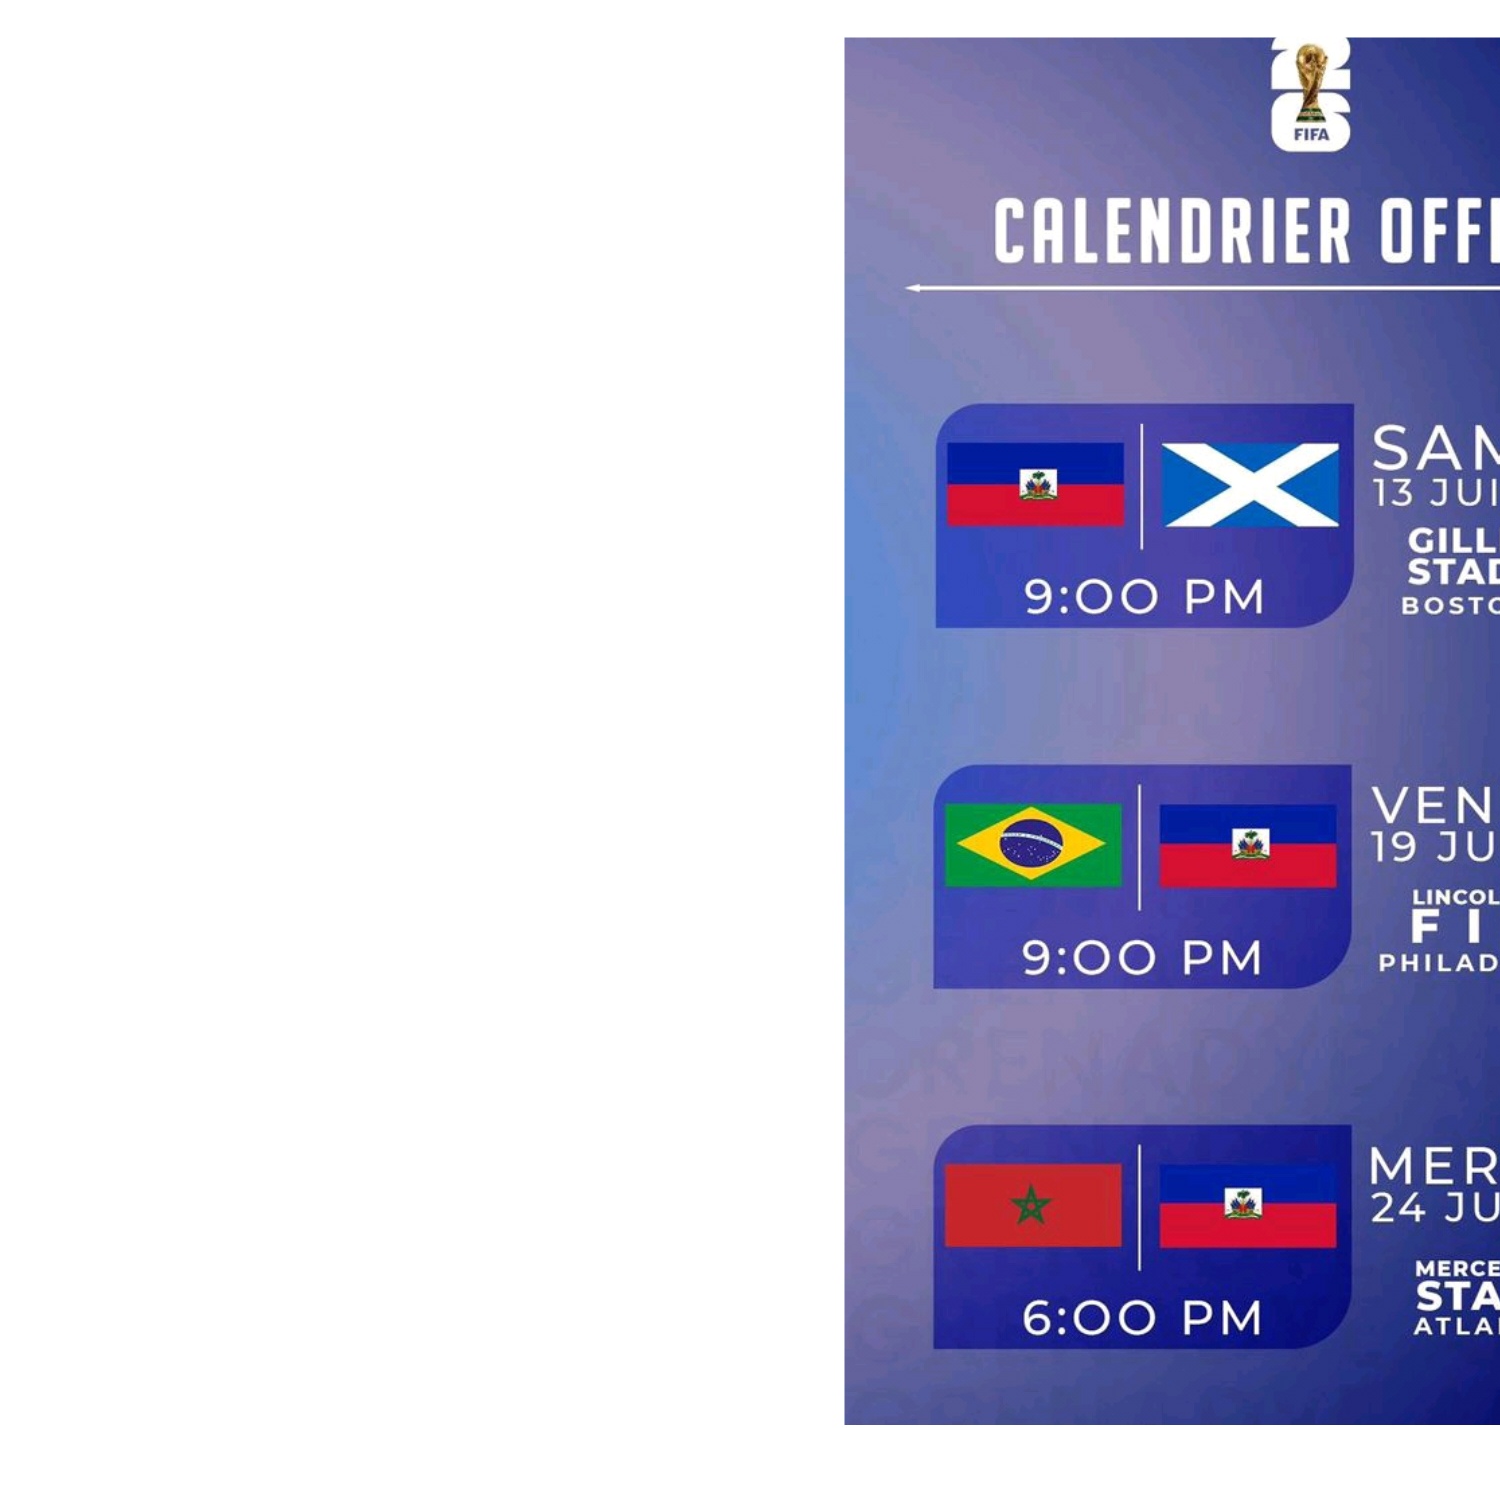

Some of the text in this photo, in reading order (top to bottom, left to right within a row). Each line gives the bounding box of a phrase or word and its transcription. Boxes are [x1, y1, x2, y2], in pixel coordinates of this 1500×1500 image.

[1294, 127, 1330, 141] FIFA
[994, 196, 1351, 265] CALENDRIER
[1372, 477, 1413, 507] 13
[1024, 578, 1264, 615] 9:00 PM
[1370, 830, 1417, 863] 19
[1022, 939, 1262, 976] 9:00 PM
[1371, 1191, 1426, 1223] 24
[1023, 1299, 1262, 1336] 6:00 PM
